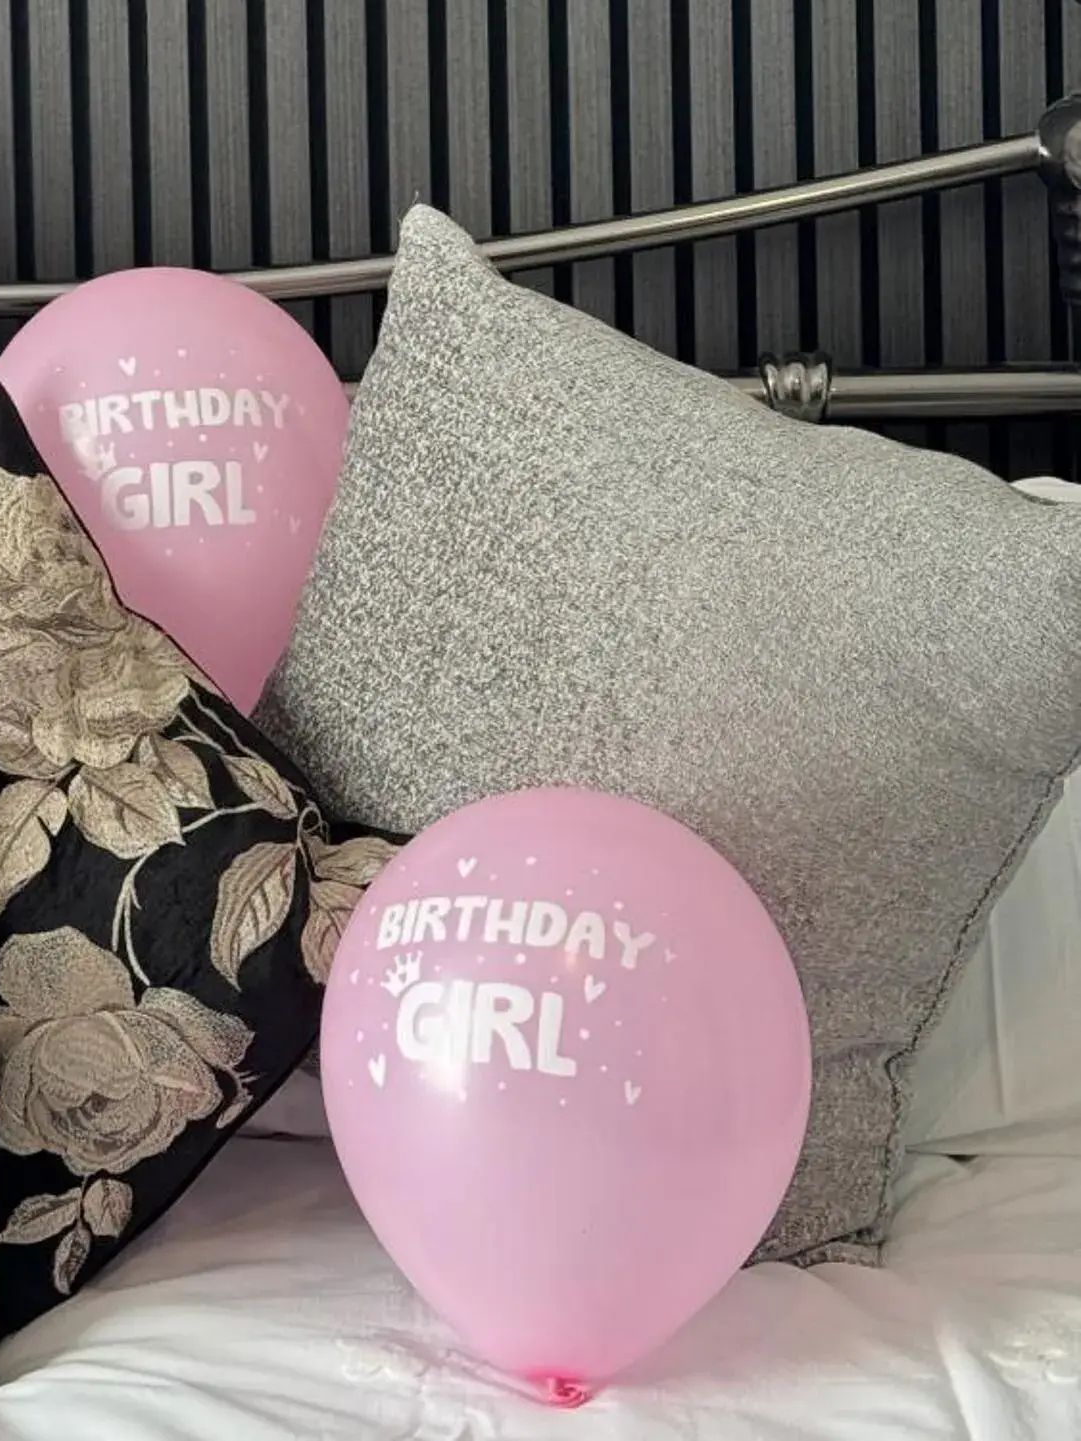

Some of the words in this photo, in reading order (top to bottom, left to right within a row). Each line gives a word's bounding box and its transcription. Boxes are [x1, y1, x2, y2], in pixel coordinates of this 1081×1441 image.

[59, 388, 290, 442] BIRTHDAY
[101, 460, 257, 530] GIRL
[376, 895, 656, 970] BIRTHDAY
[396, 979, 578, 1077] GIRL
